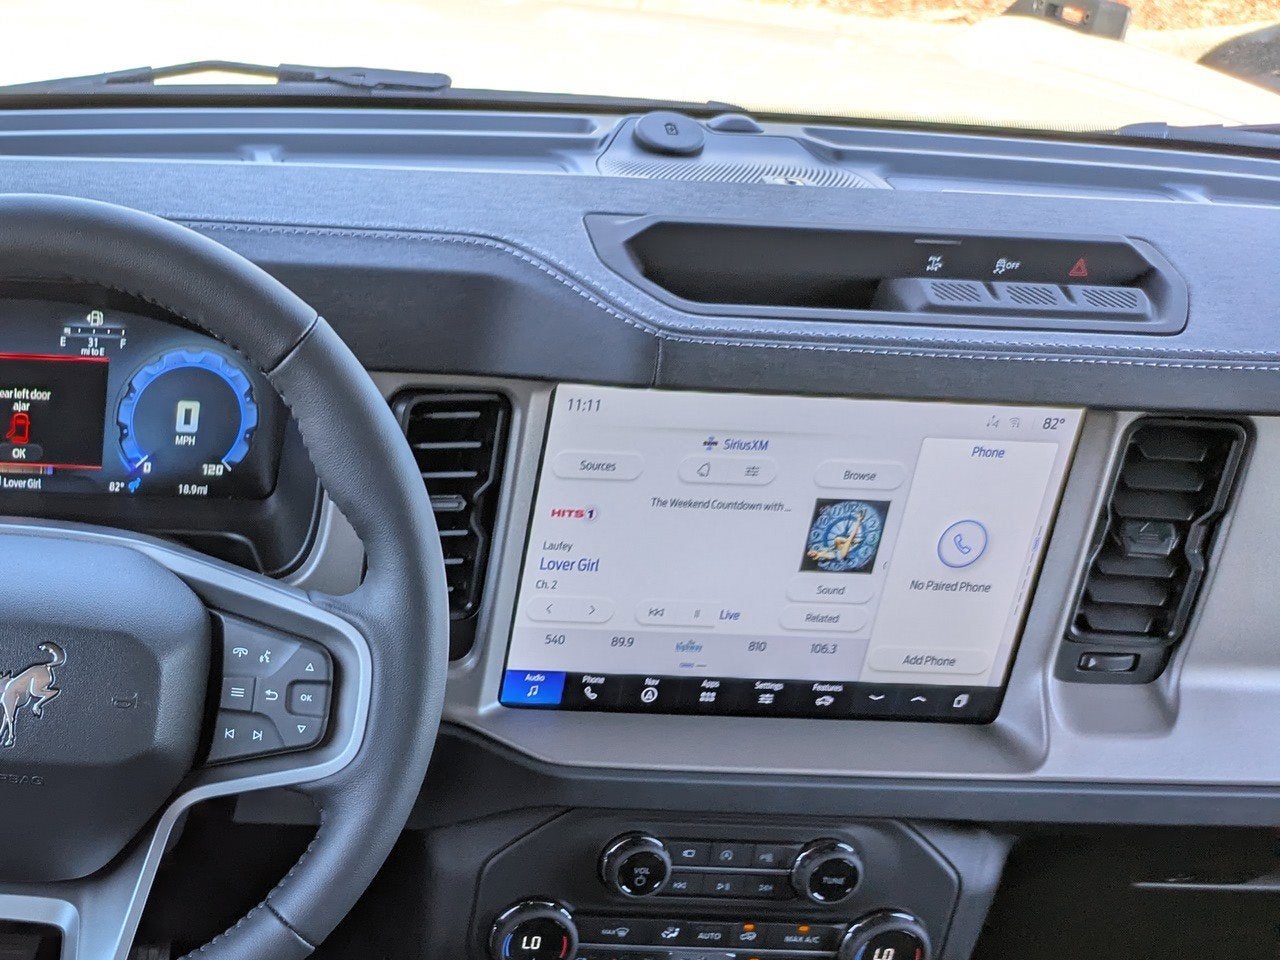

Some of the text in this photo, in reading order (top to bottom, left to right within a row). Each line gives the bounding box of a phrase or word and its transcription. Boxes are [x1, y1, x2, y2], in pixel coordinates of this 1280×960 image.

[1005, 261, 1020, 270] OFF
[60, 336, 67, 347] E
[88, 336, 99, 348] 31
[120, 338, 127, 349] F
[91, 347, 99, 356] to
[100, 347, 105, 356] E
[13, 387, 29, 399] left
[30, 388, 51, 400] door
[13, 400, 30, 412] ajar
[568, 398, 601, 412] 11:11
[175, 400, 200, 433] 0
[1042, 417, 1066, 430] 82°
[175, 435, 196, 446] MPH
[723, 438, 769, 451] SiriusXM
[12, 448, 26, 459] OK
[971, 446, 1005, 459] Phone
[143, 462, 152, 473] 0
[202, 464, 223, 475] 120
[580, 459, 616, 472] Sources
[843, 469, 877, 482] Browse
[3, 477, 41, 489] Lover Girl
[651, 497, 668, 507] The
[669, 498, 710, 509] Weekend
[711, 499, 762, 511] Countdown
[551, 508, 596, 519] HITS 1
[543, 540, 574, 552] Laufey
[539, 556, 600, 572] Lover Girl
[535, 580, 558, 590] Ch. 2
[816, 585, 846, 596] Sound
[909, 580, 991, 593] No Paired Phone
[719, 609, 741, 621] Live
[805, 613, 840, 624] Related
[544, 634, 566, 645] 540
[611, 636, 635, 647] 89.9
[748, 640, 768, 652] 810
[810, 643, 838, 655] 106.3
[902, 654, 956, 667] Add Phone
[524, 673, 546, 682] Audio
[582, 675, 606, 685] Phone
[644, 677, 660, 686] Nav
[754, 680, 784, 691] Settings
[812, 682, 844, 692] Features
[300, 693, 313, 702] OK
[697, 932, 722, 941] AUTO
